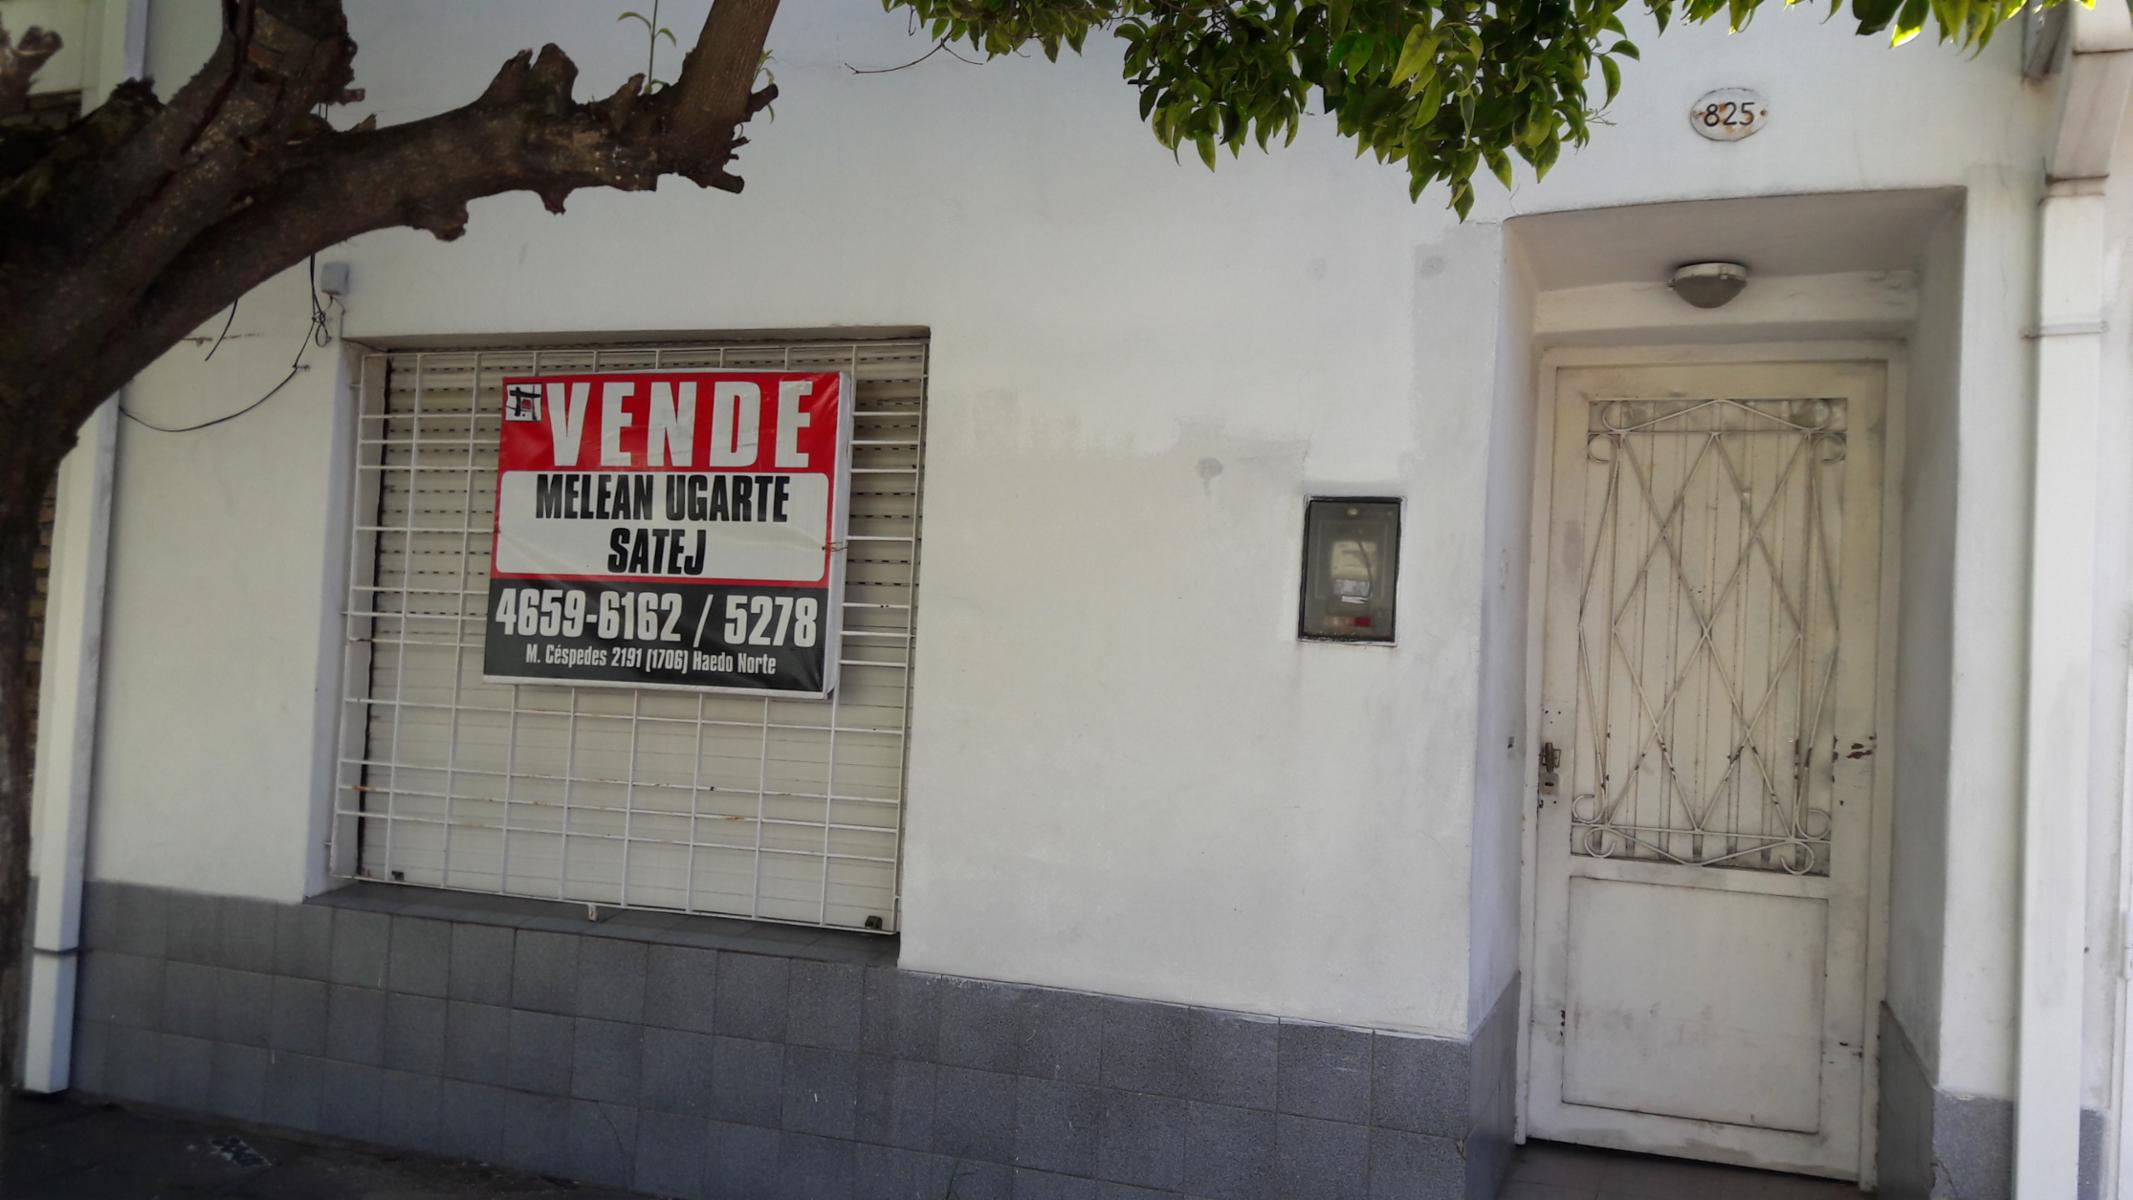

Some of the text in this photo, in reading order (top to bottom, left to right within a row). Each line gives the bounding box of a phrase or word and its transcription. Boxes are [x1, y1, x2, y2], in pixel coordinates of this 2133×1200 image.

[1703, 101, 1755, 127] 825
[546, 380, 813, 467] VENDE
[536, 474, 790, 522] MELEAN UGARTE
[607, 527, 706, 575] SATEJ
[495, 588, 818, 648] 4659-6162 / 5278
[525, 643, 541, 664] M.
[545, 644, 607, 668] Céspedes
[610, 646, 642, 668] 2191
[692, 651, 733, 673] Haedo
[737, 653, 777, 675] Norte
